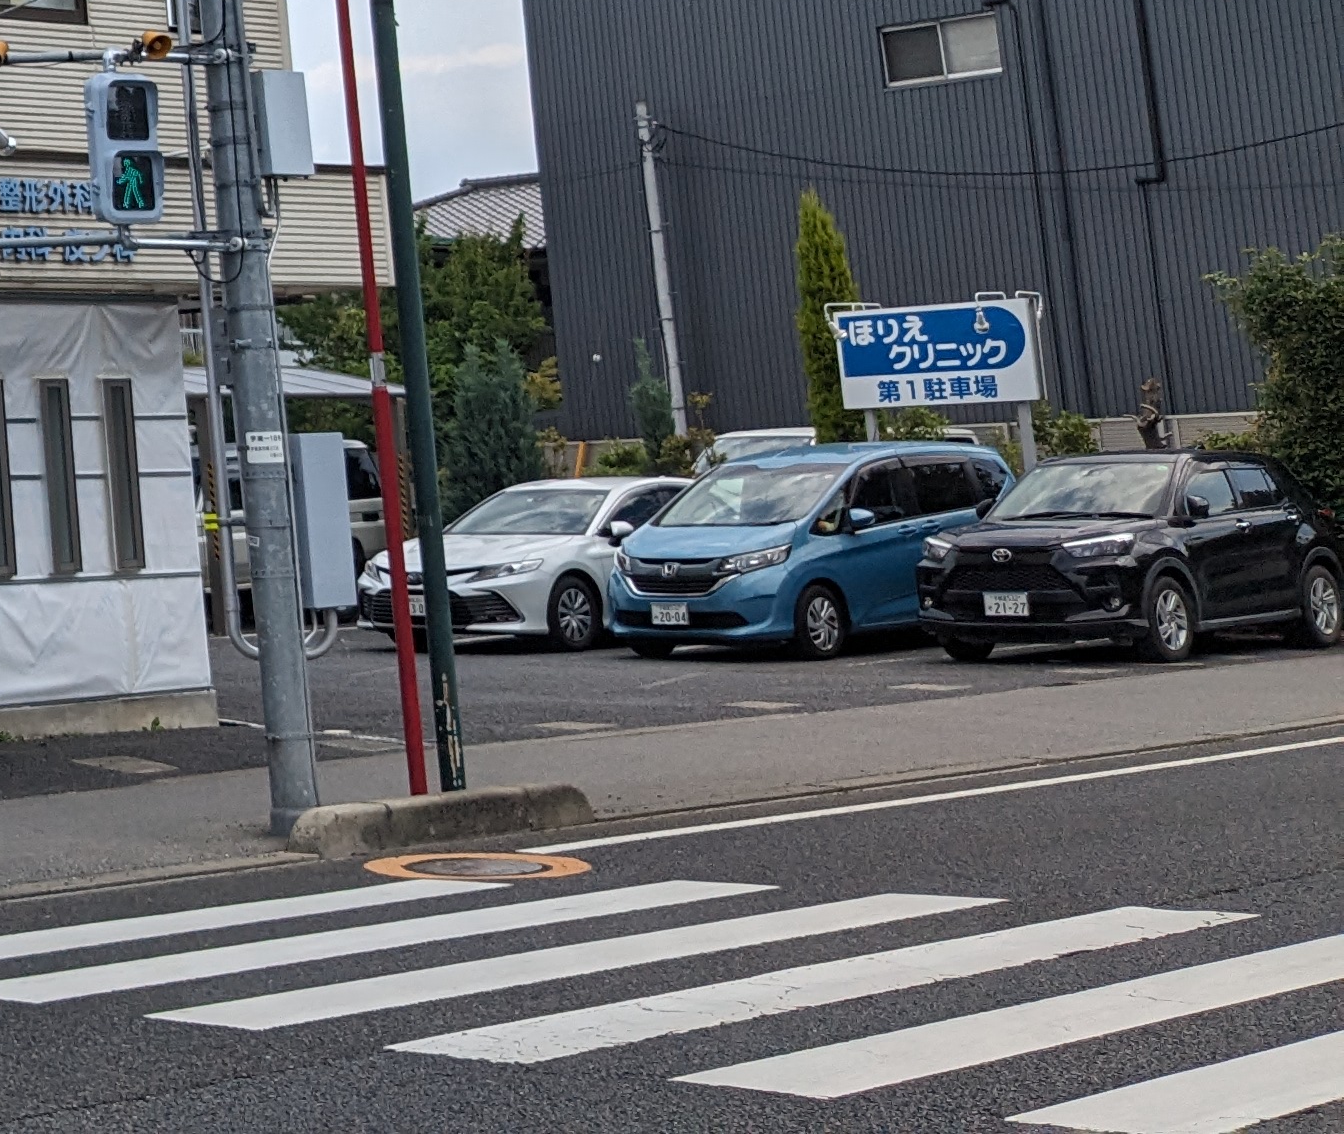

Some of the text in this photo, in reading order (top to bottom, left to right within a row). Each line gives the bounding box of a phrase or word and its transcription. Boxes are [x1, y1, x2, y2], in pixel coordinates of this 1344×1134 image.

[848, 315, 929, 347] ほりえ
[888, 338, 1008, 370] クリニック
[877, 374, 999, 404] 第1駐車場
[659, 611, 687, 623] 20-04
[994, 602, 1026, 614] 21-27
